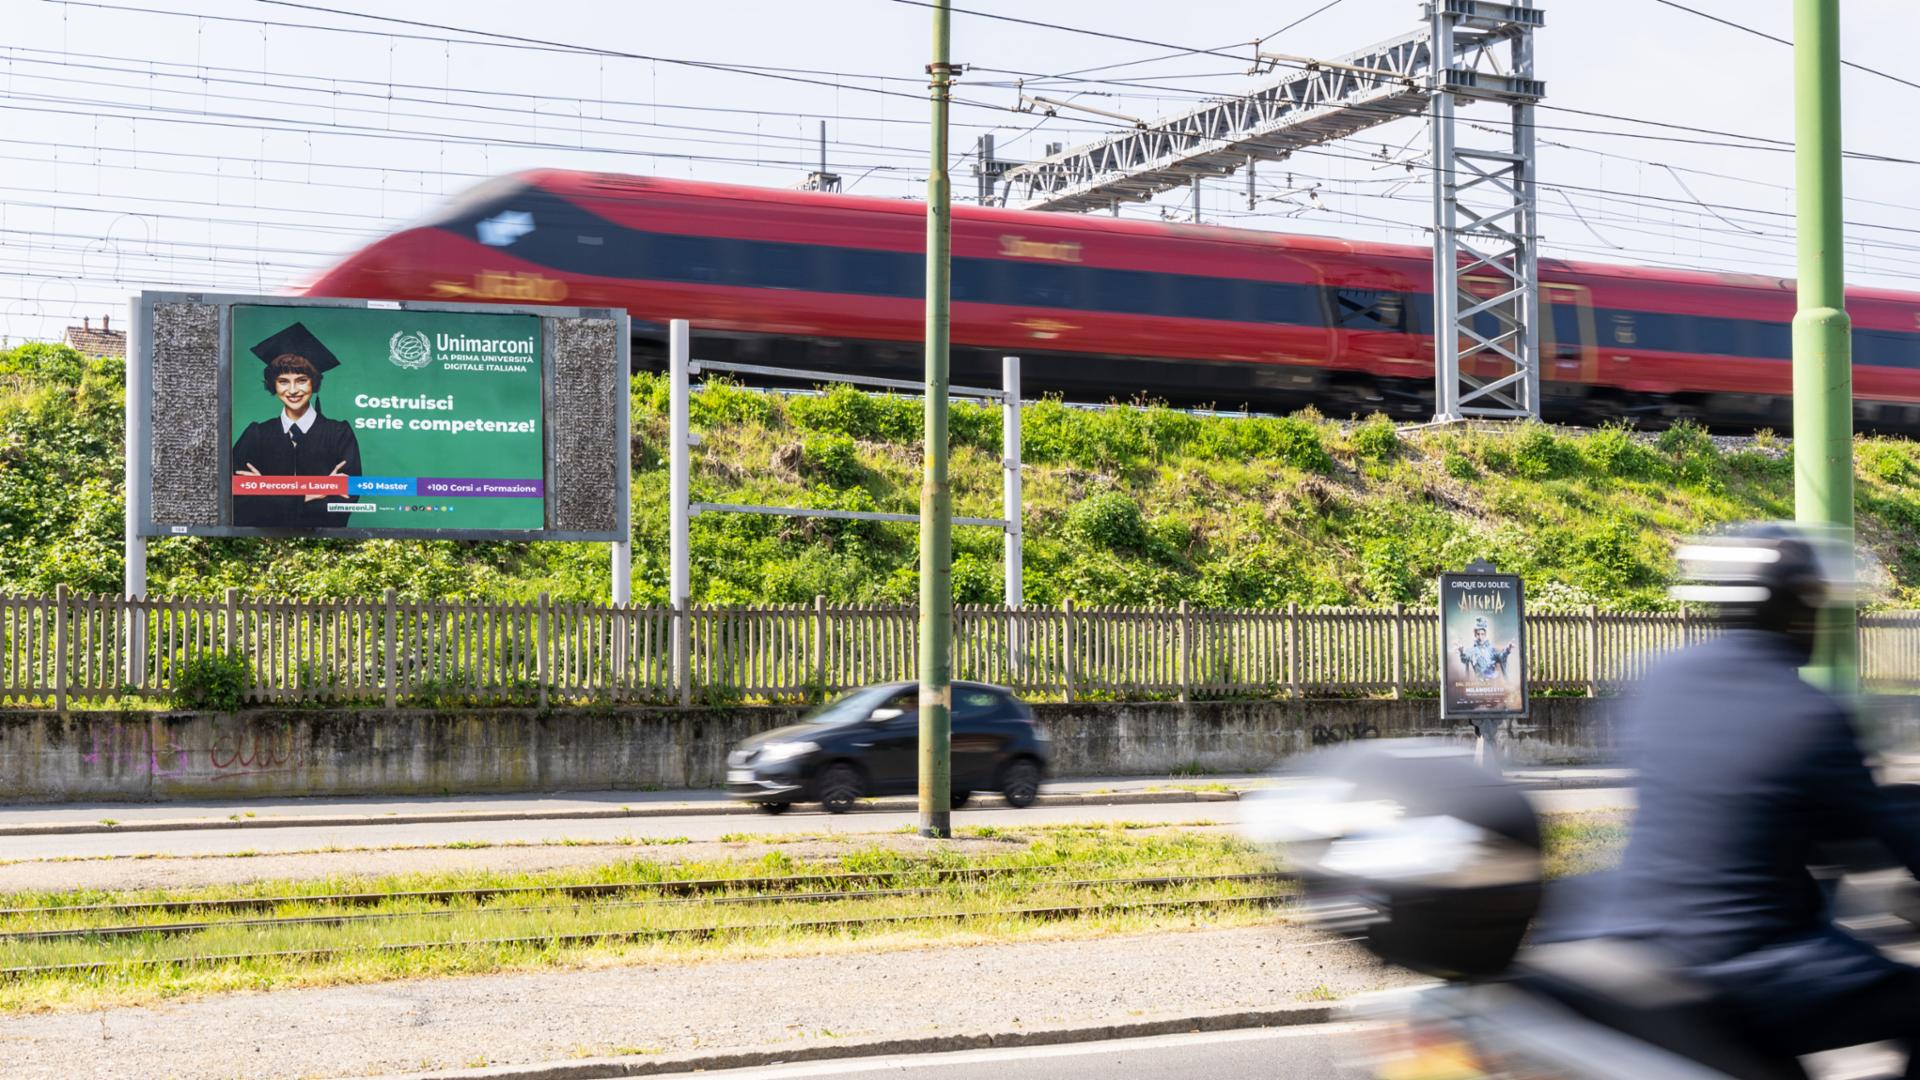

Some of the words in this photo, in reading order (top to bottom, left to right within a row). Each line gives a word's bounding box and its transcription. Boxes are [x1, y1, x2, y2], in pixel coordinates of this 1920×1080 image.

[436, 333, 534, 354] Unimarconi
[437, 353, 449, 361] LA
[450, 354, 480, 362] PRIMA
[481, 354, 534, 363] UNIVERSITÀ
[444, 363, 484, 371] DIGITALE
[486, 364, 527, 372] ITALIANA
[354, 394, 454, 411] Costruisci
[354, 414, 404, 430] serie
[408, 418, 535, 434] competenze!
[240, 482, 257, 490] +50
[259, 481, 299, 490] Percorsi
[357, 482, 374, 490] +50
[375, 482, 409, 491] Master
[427, 483, 448, 491] +100
[450, 483, 474, 492] Corsi
[483, 484, 537, 493] Formazione
[1451, 581, 1476, 590] CIRQUE
[1488, 581, 1511, 589] SOLEIL
